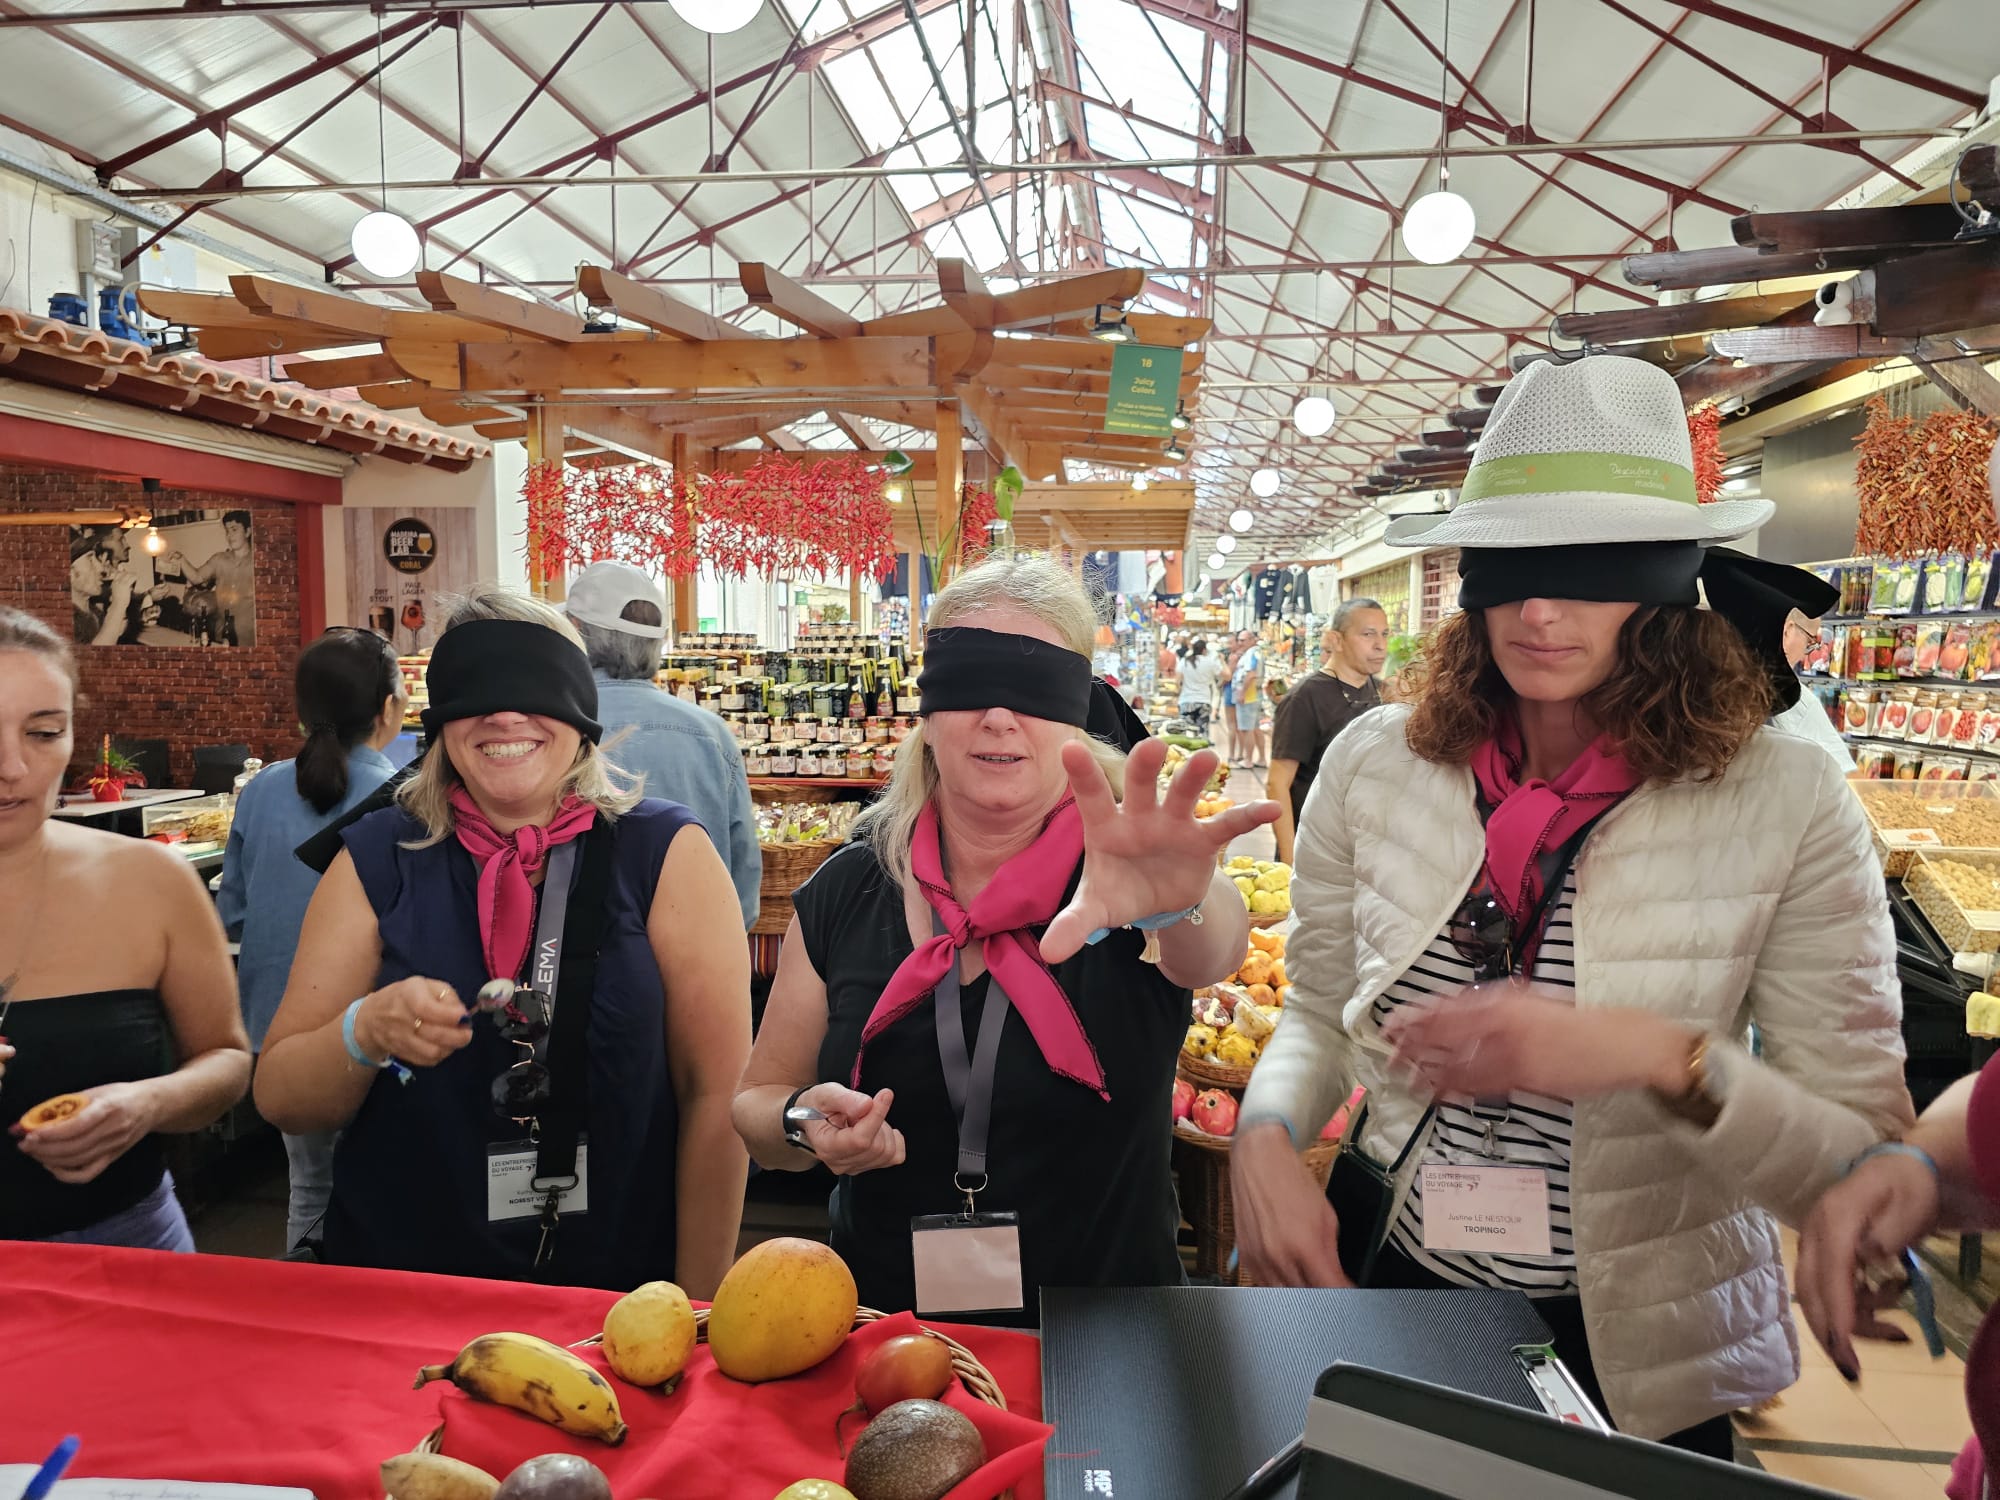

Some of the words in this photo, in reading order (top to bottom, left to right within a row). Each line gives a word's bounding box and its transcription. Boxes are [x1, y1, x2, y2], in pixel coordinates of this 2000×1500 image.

[1141, 358, 1153, 368] 18
[391, 537, 414, 546] BEER
[391, 546, 410, 555] LAB
[1464, 1225, 1506, 1235] TROPINGO
